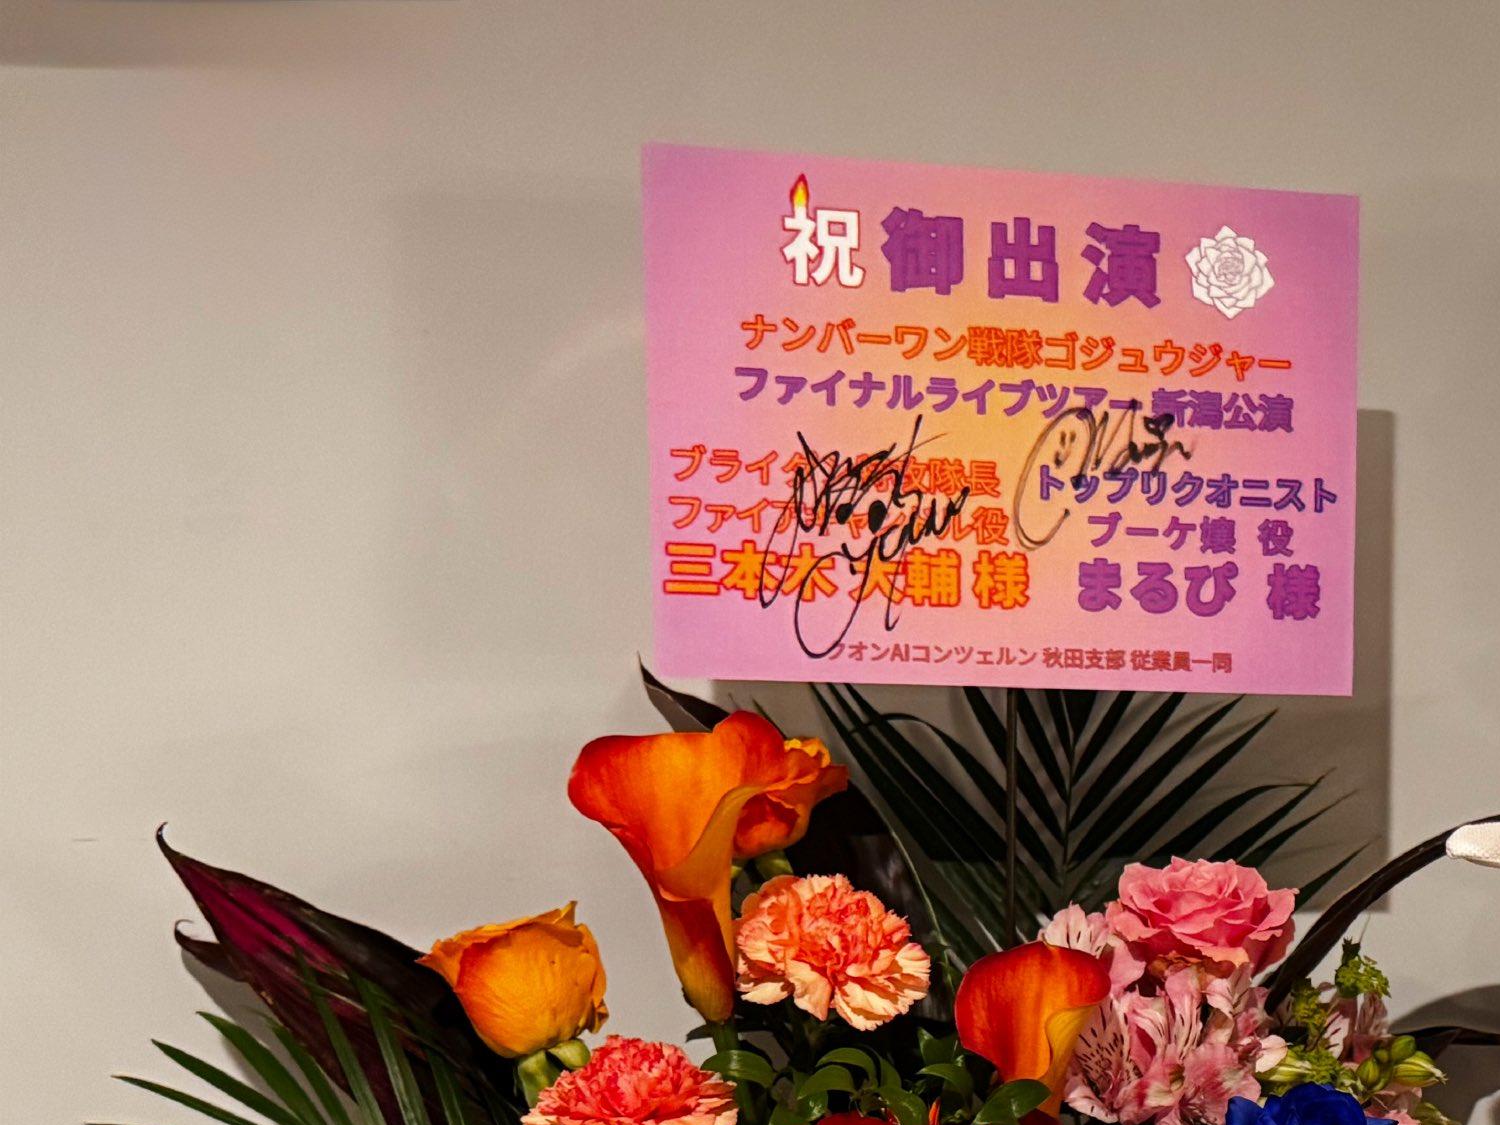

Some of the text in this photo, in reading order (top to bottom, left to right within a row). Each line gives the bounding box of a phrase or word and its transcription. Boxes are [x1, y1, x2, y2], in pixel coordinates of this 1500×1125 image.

[781, 206, 1162, 309] 祝 御出演
[740, 314, 1293, 382] ナンバーワン戦隊ゴジュウジャー
[734, 366, 1295, 433] ファイナルライブツアー 新潟公演
[1087, 511, 1295, 558] ブーケ嬢 役
[663, 539, 1030, 609] 三本木 大輔 様
[1077, 557, 1321, 621] まるぴ 様
[1042, 646, 1127, 671] 秋田支部
[1130, 649, 1233, 674] 従業員一同
